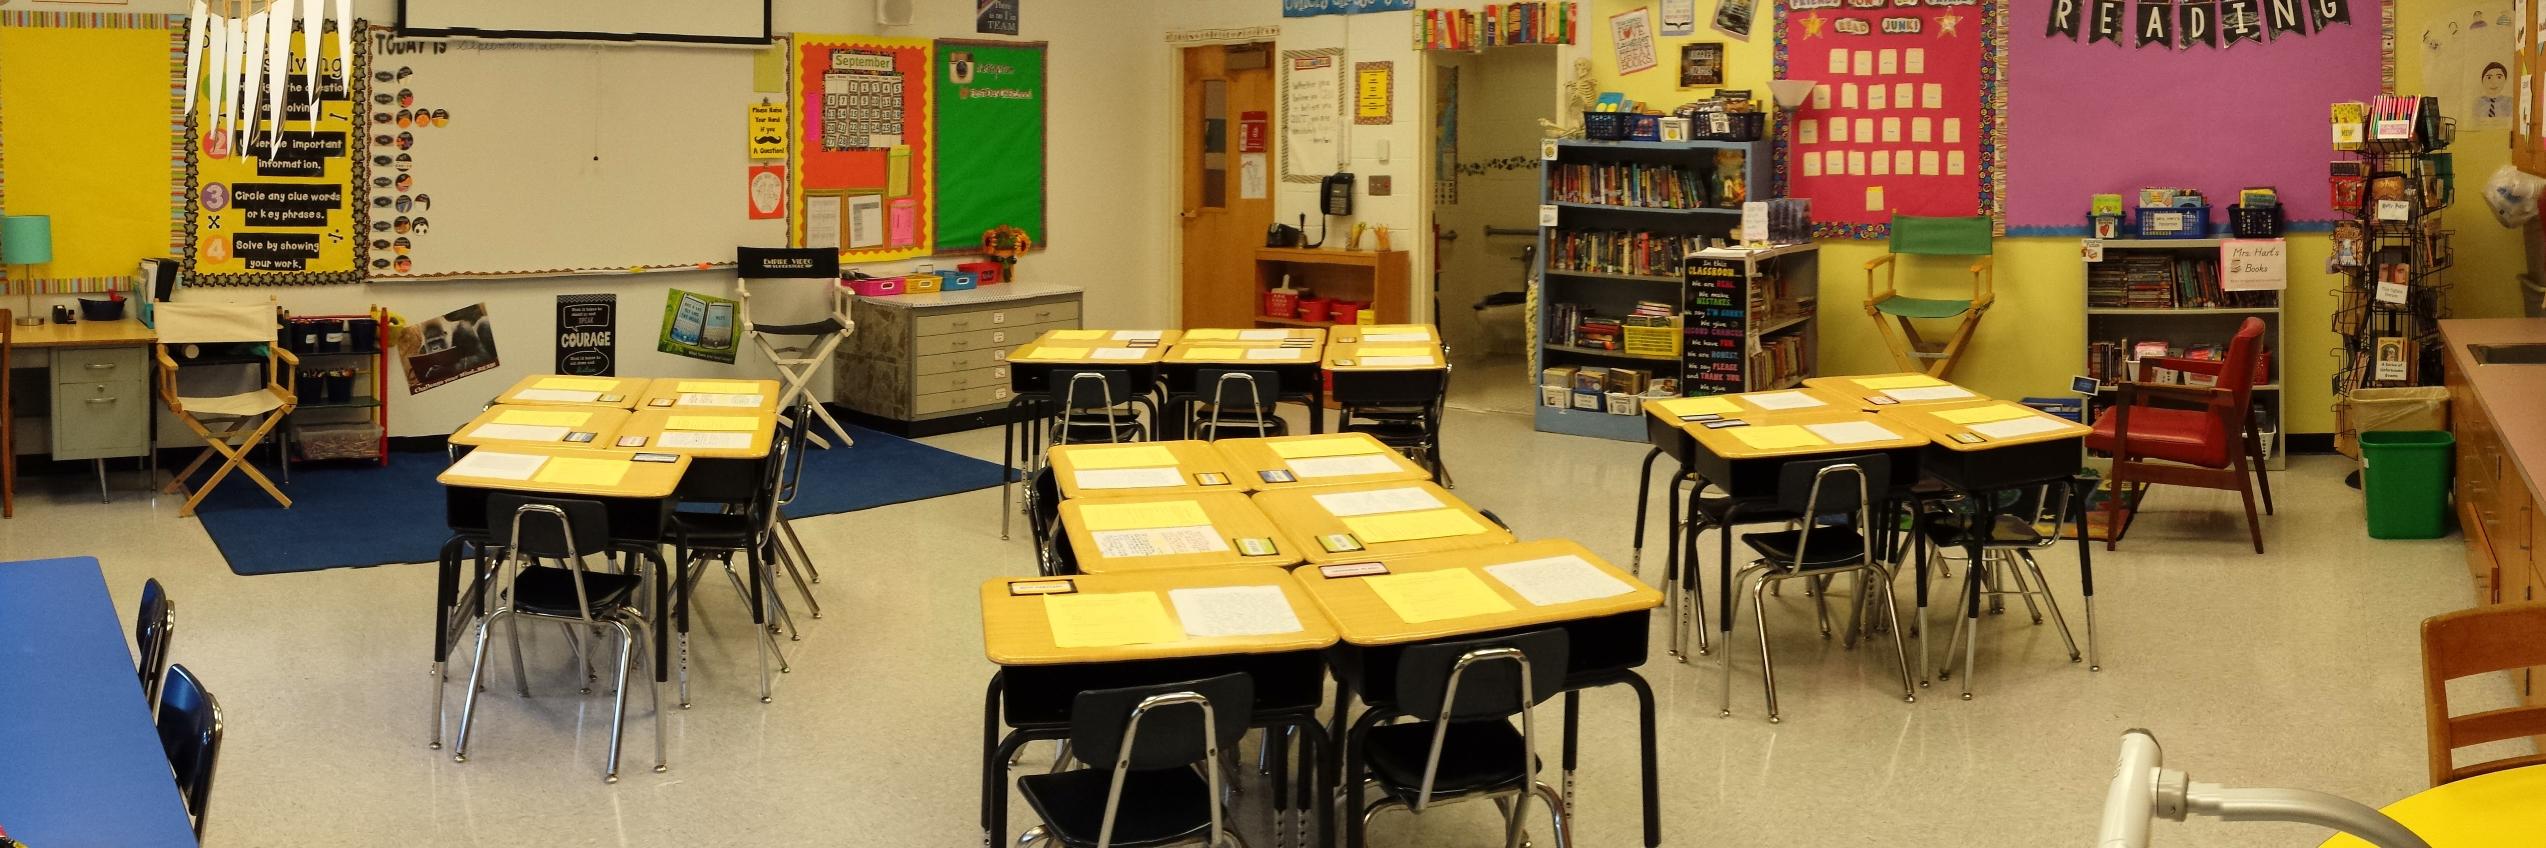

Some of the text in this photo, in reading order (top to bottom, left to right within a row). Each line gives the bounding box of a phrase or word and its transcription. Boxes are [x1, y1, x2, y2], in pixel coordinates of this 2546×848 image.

[2055, 0, 2338, 38] READING
[988, 21, 1016, 31] TEAM
[1885, 20, 1918, 31] JUNK!
[835, 55, 890, 68] September
[292, 139, 342, 150] important
[259, 159, 321, 170] information.
[206, 184, 224, 210] 3
[235, 190, 341, 202] Circle any clue words
[260, 210, 280, 220] key
[282, 210, 325, 220] phrases.
[206, 237, 226, 259] 4
[236, 240, 320, 253] Solve by showing
[2233, 247, 2280, 257] Mrs. Hart's
[250, 260, 302, 269] your work.
[2245, 264, 2268, 273] Books
[561, 331, 612, 348] COURAGE
